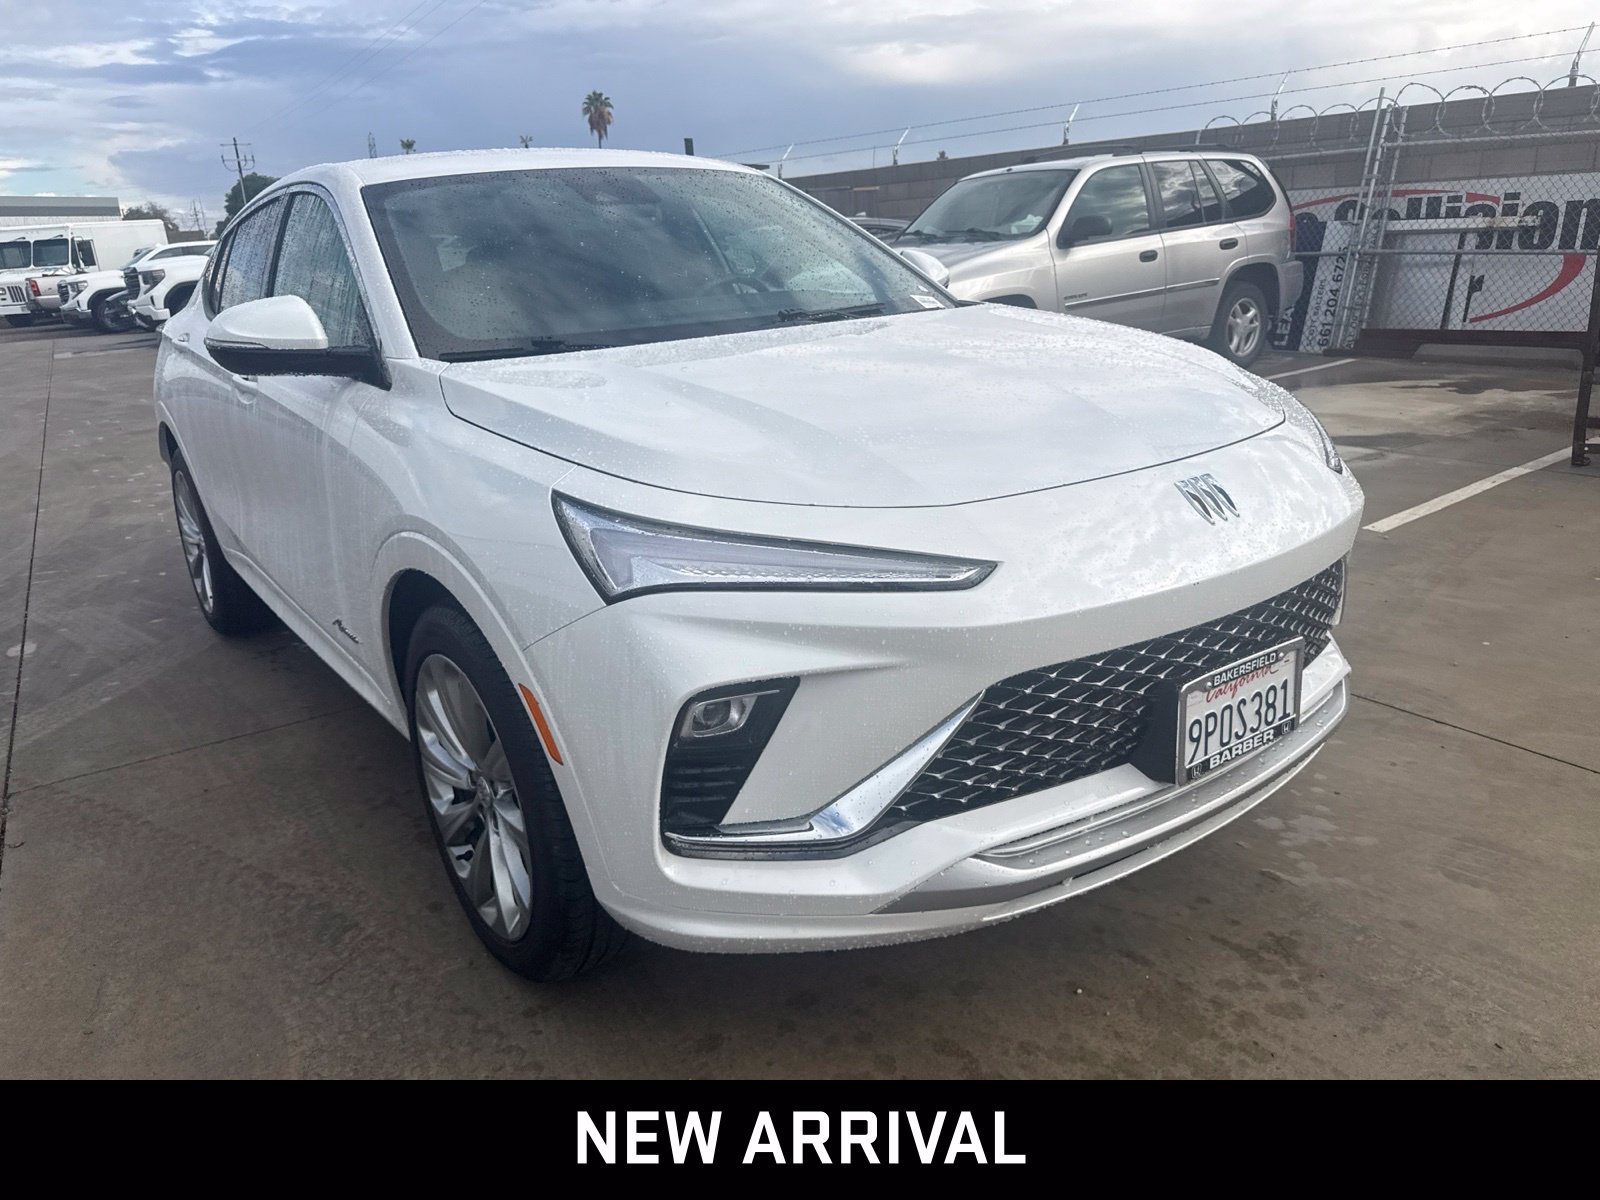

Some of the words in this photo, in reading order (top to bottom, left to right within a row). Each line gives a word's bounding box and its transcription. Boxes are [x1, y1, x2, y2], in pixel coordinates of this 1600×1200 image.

[1323, 288, 1340, 316] 204
[1316, 322, 1332, 346] 661
[1213, 652, 1277, 687] BAKERSFIELD
[1209, 728, 1275, 769] BARBER
